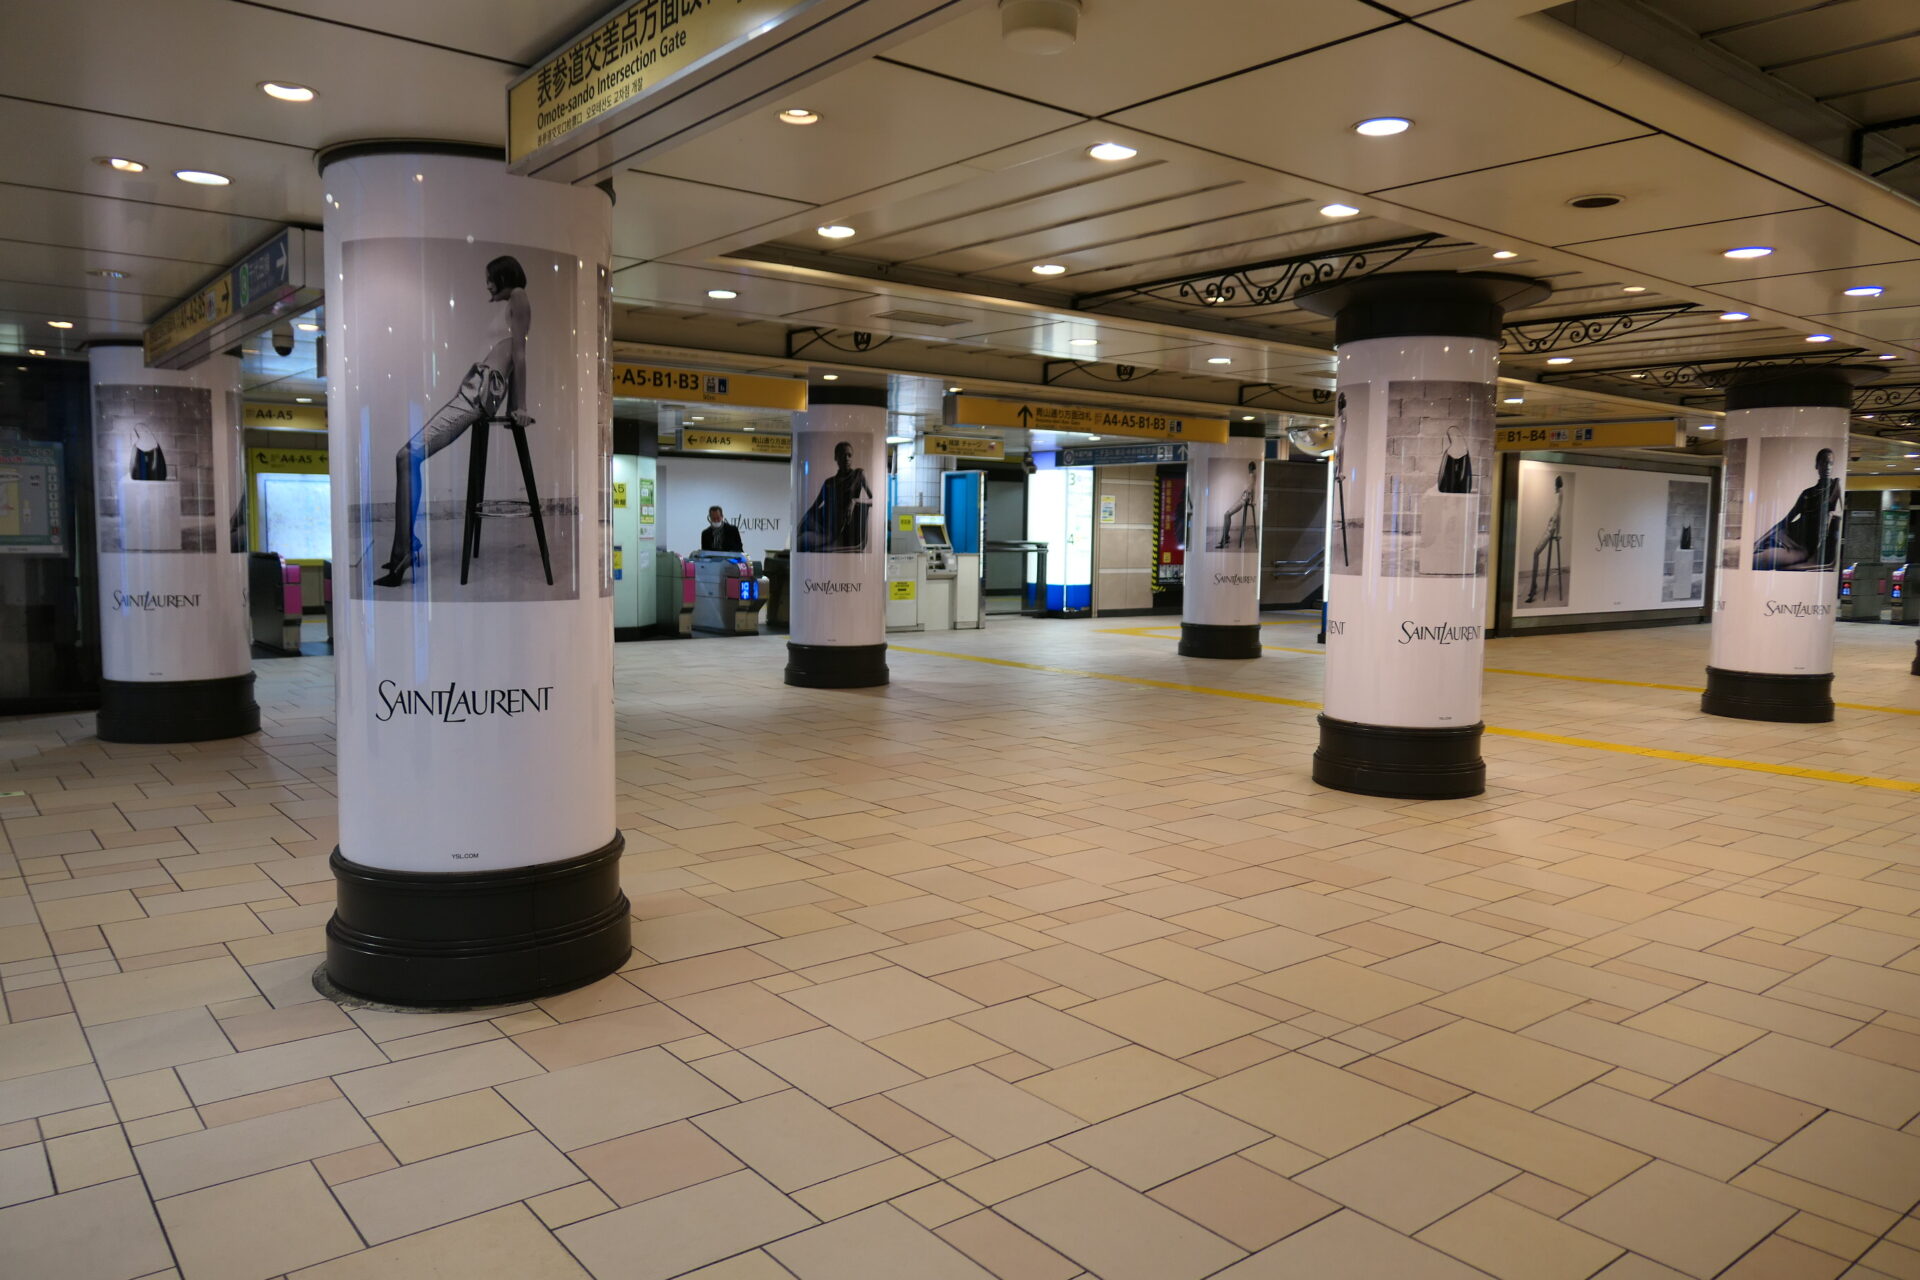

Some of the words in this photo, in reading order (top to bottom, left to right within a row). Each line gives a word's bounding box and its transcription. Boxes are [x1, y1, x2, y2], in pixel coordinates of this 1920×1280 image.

[537, 83, 595, 130] Omote-sando
[597, 48, 657, 95] Intersection
[660, 30, 687, 57] Gate
